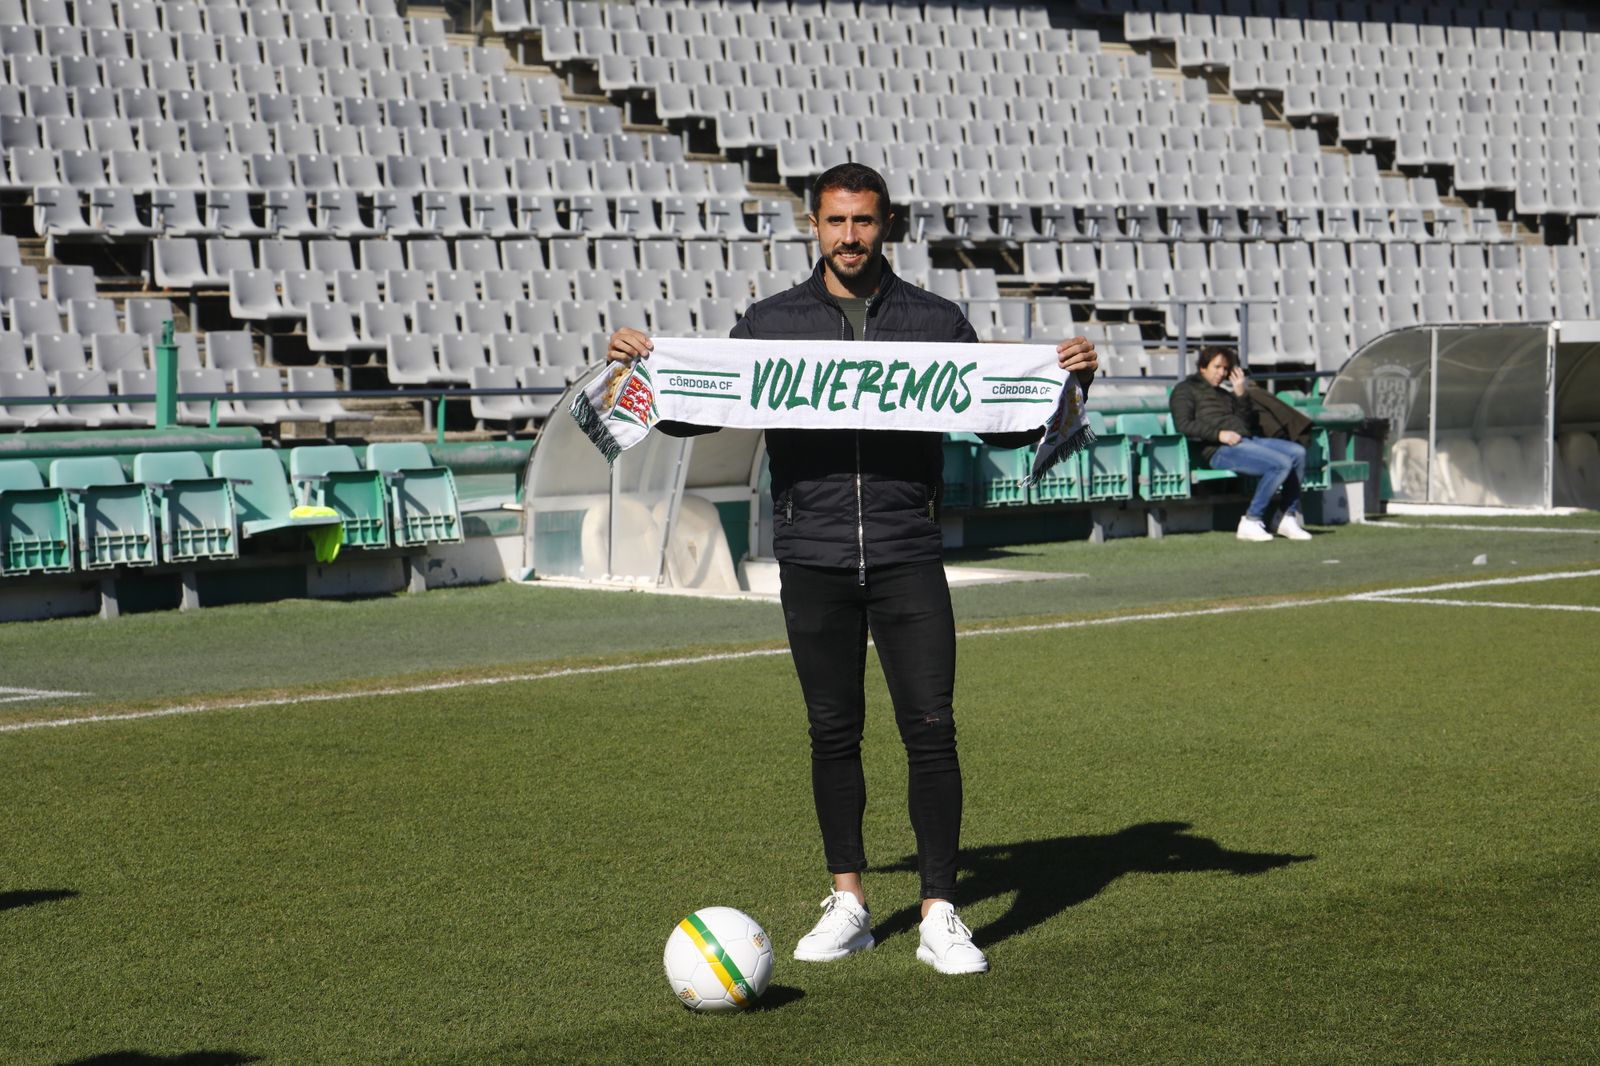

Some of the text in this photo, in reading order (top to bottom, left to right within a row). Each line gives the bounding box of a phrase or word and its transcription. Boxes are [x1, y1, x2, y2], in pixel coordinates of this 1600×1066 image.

[719, 381, 733, 390] CF
[751, 359, 976, 413] VOLVEREMOS
[1039, 386, 1052, 395] CF
